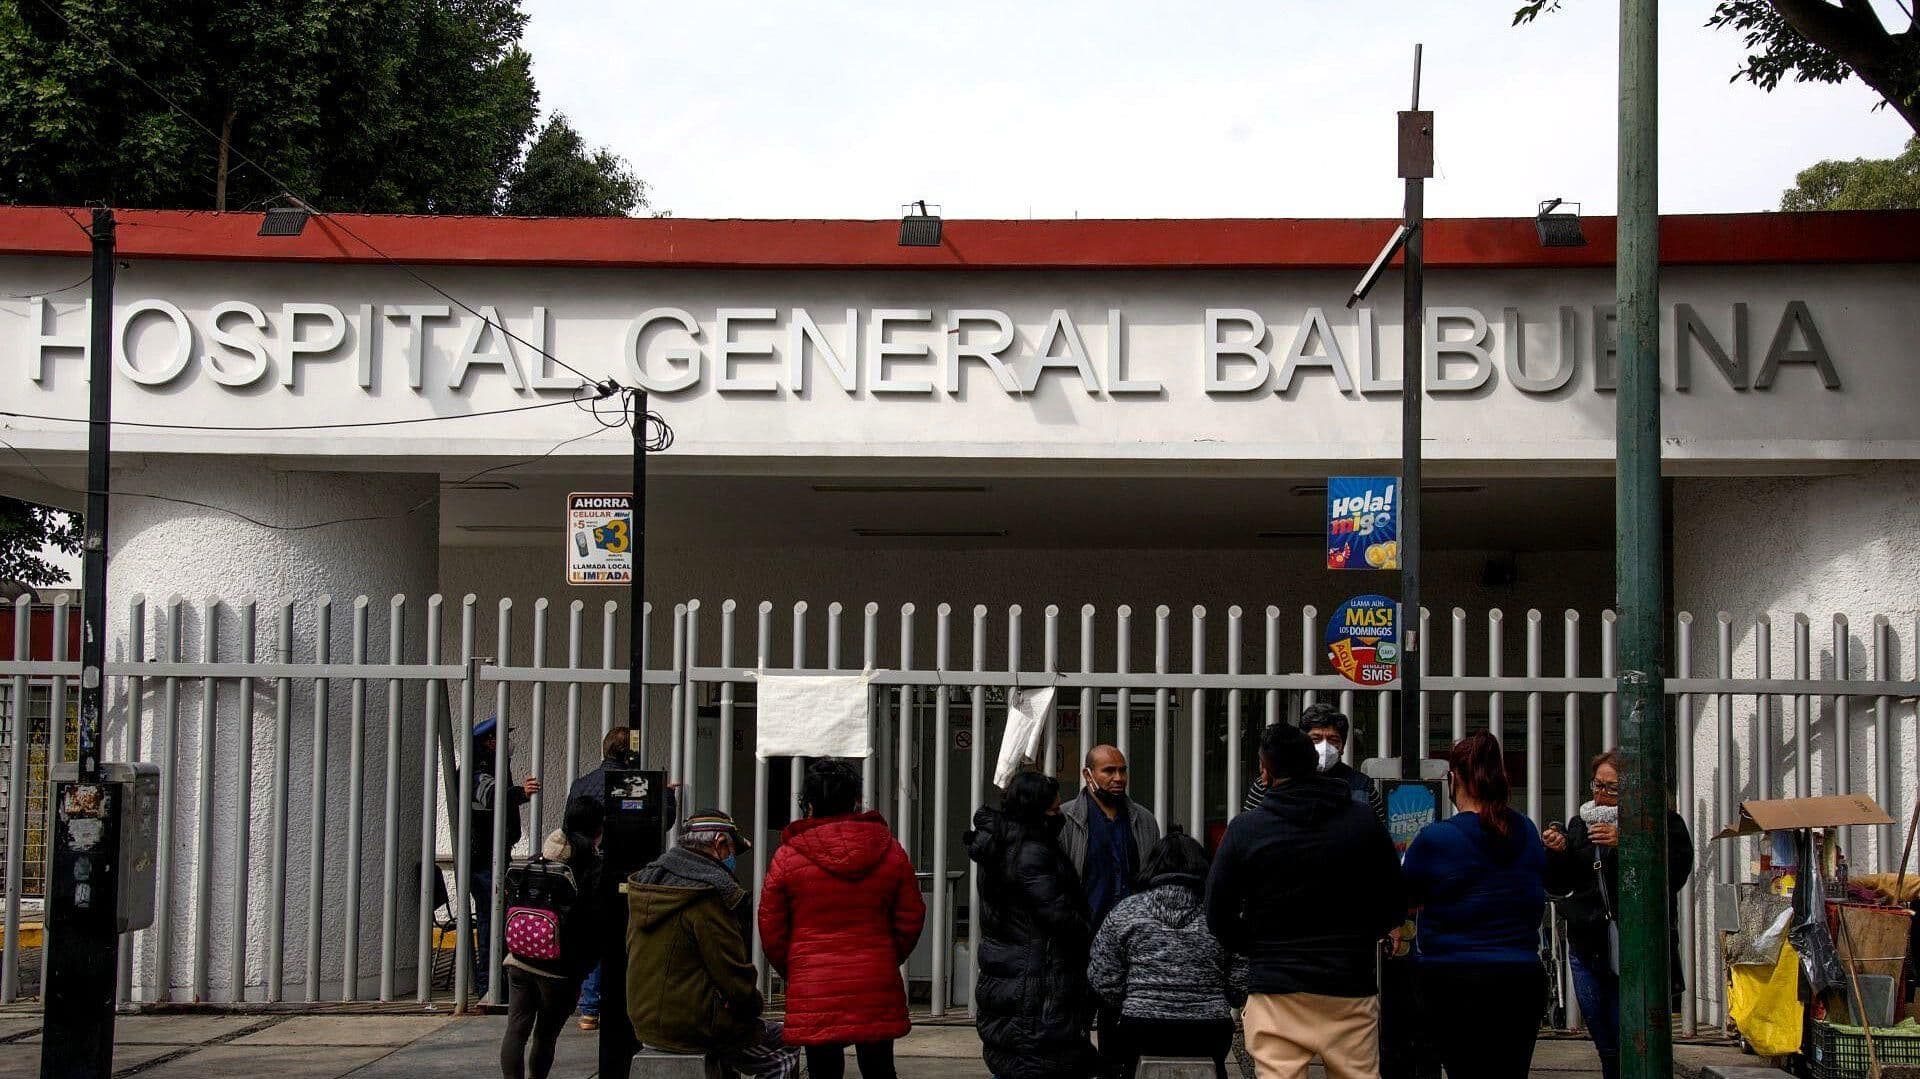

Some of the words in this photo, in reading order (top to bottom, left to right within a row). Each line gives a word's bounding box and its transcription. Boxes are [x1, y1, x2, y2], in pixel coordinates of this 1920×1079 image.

[29, 296, 585, 392] HOSPITAL
[624, 306, 1163, 396] GENERAL
[575, 498, 629, 508] AHORRA
[1332, 484, 1394, 518] Hola!
[573, 571, 630, 580] ILIMITADA
[1345, 607, 1393, 627] MÁS!
[1340, 626, 1350, 634] LOS
[1350, 626, 1393, 636] DOMINGOS
[1362, 669, 1393, 681] SMS
